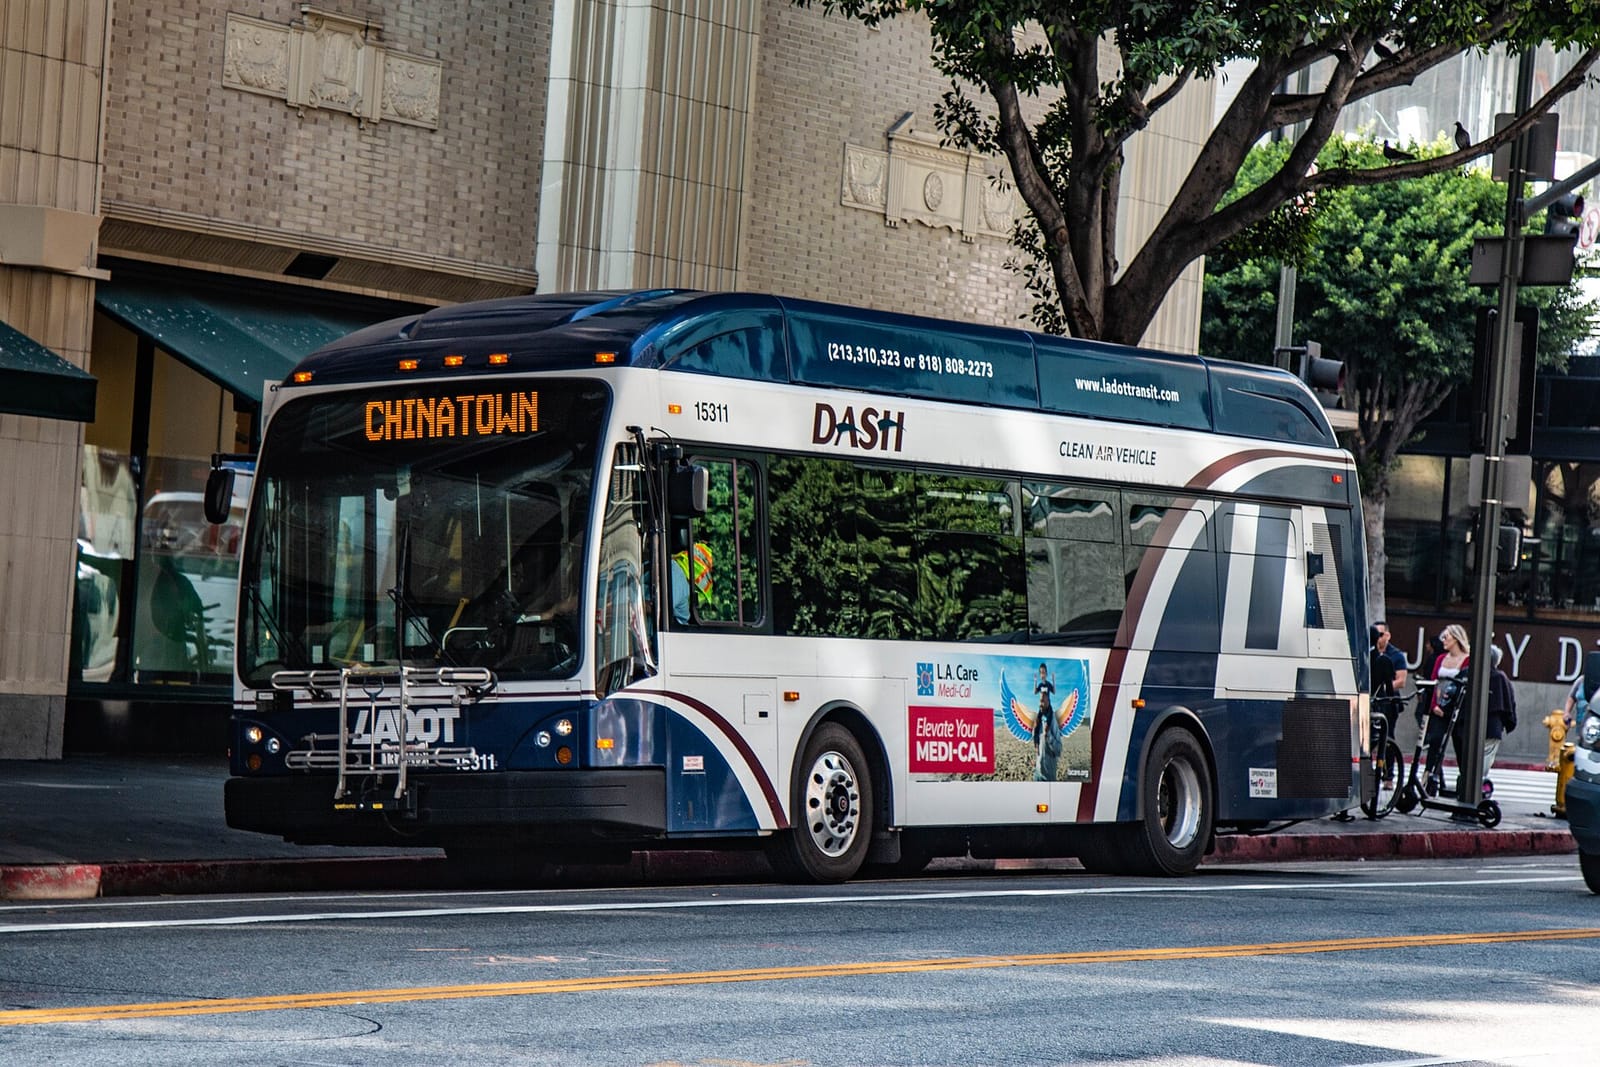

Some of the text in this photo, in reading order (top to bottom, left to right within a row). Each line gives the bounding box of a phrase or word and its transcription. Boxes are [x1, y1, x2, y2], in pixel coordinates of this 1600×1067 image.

[828, 342, 993, 378] (213,310,323 or 818) 808-2273
[1075, 377, 1180, 402] www.ladottransit.com
[365, 391, 538, 441] CHINATOWN
[694, 402, 729, 423] 15311
[812, 403, 906, 452] DASH
[1059, 441, 1157, 466] CLEAN AIR VEHICLE
[937, 663, 978, 681] L.A. Care
[938, 683, 972, 698] Medi-Cal
[352, 707, 460, 745] LADOT
[916, 717, 979, 738] Elevate Your
[916, 740, 988, 763] MEDI-CAL
